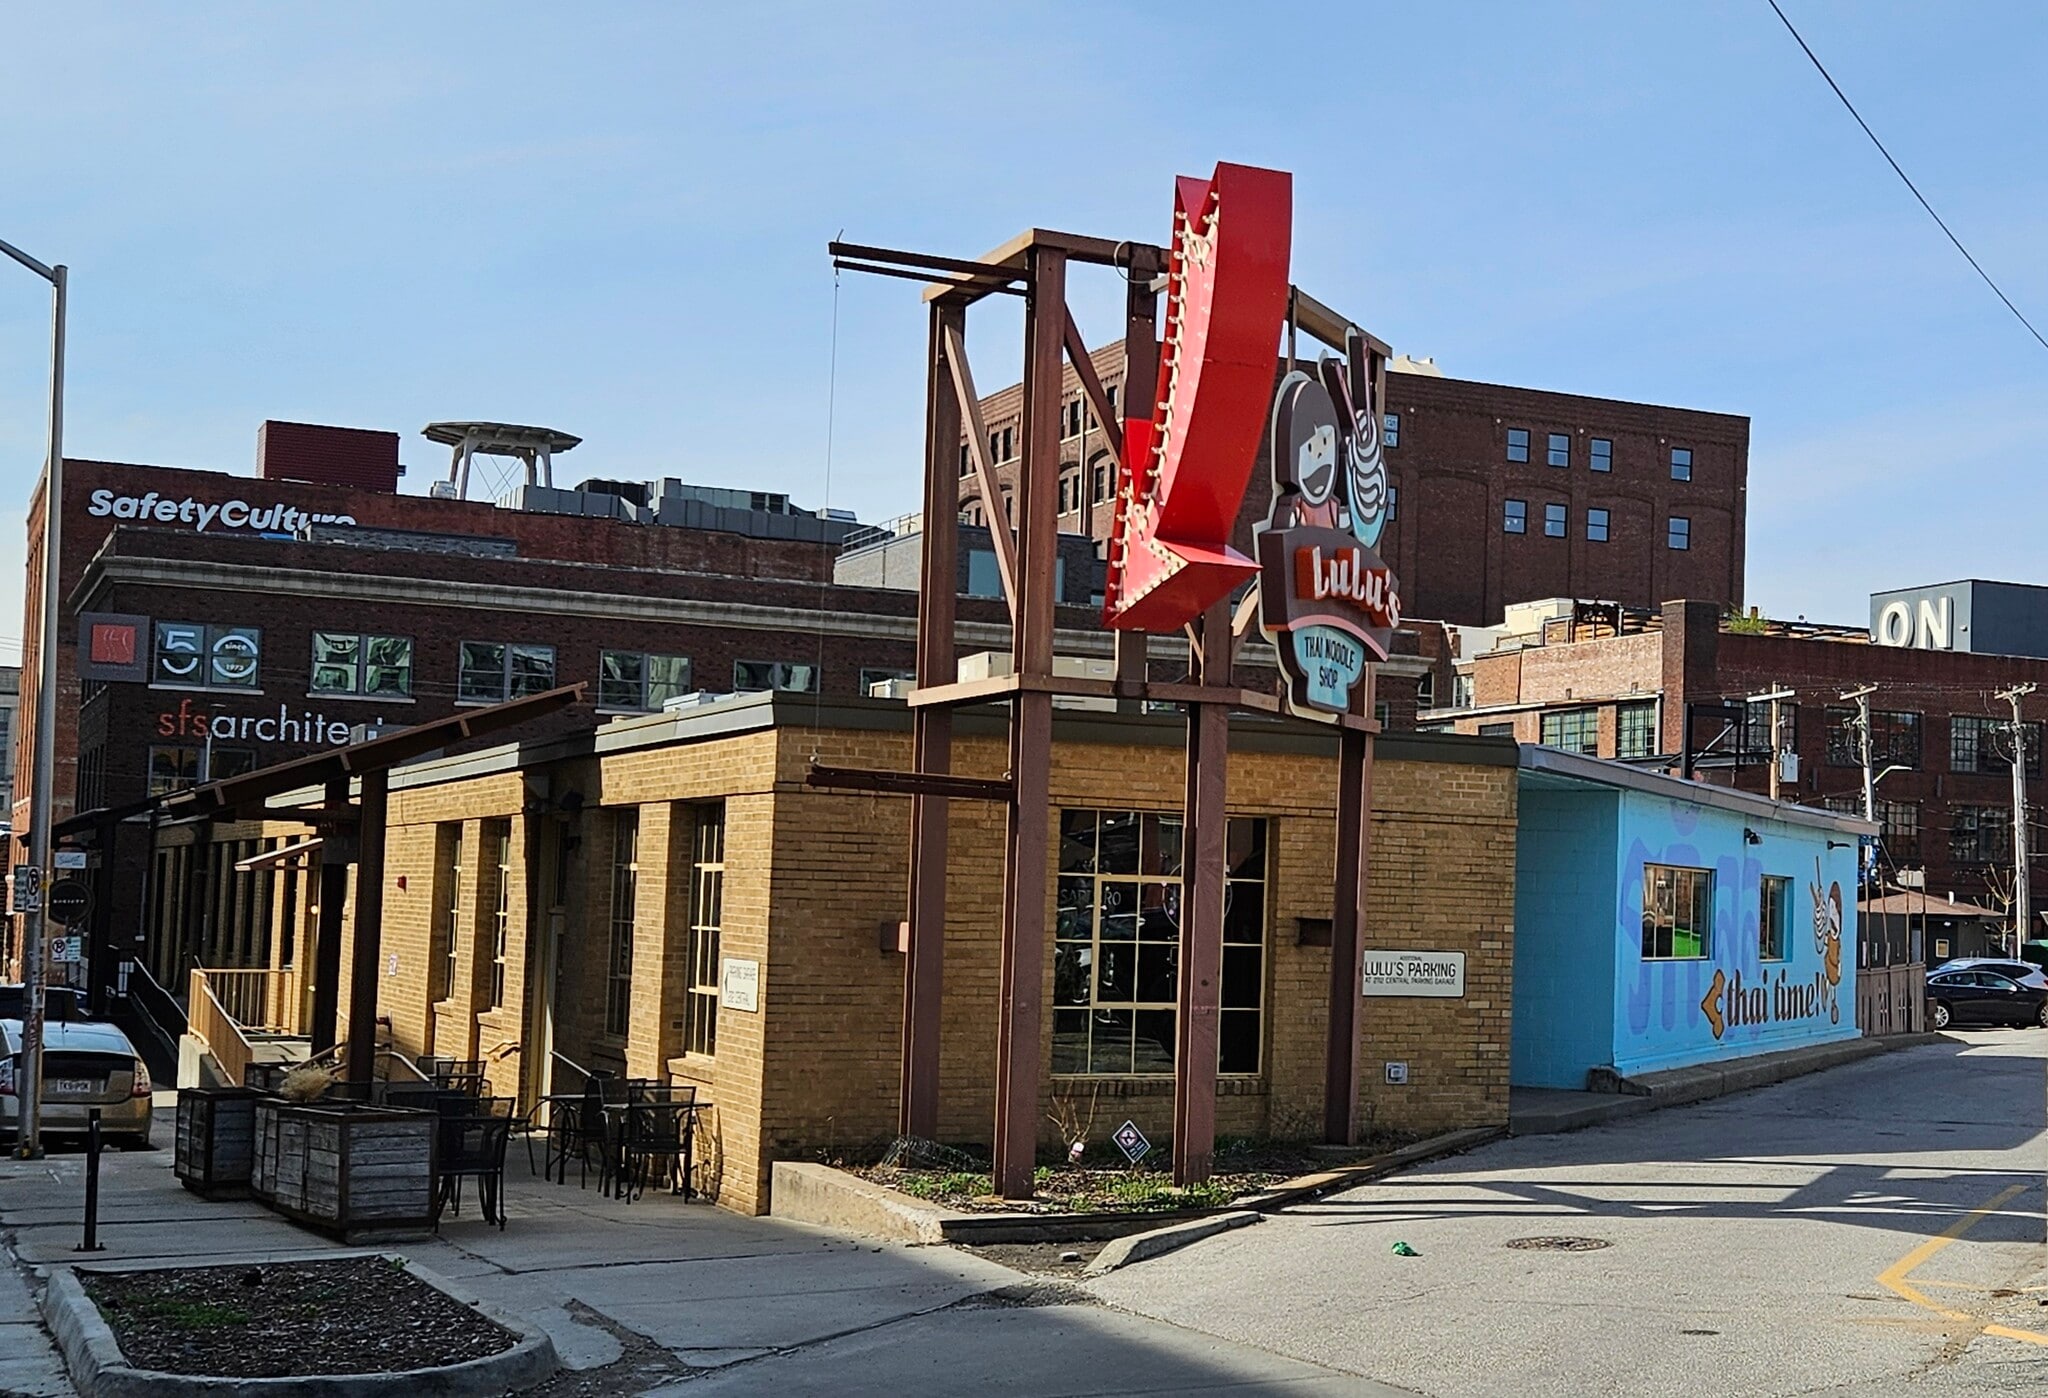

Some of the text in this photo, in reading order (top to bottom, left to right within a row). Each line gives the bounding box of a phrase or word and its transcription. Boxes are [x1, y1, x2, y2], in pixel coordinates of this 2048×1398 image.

[1879, 596, 1952, 649] ON
[1304, 636, 1355, 671] THAI NOODLE
[1319, 666, 1338, 689] SHOP
[1364, 961, 1456, 978] LULU'S PARKING
[1365, 976, 1372, 984] AT
[1385, 976, 1410, 985] CENTRAL
[1410, 977, 1434, 985] PARKING
[1434, 977, 1456, 986] GARAGE
[1726, 968, 1820, 1027] thai time!
